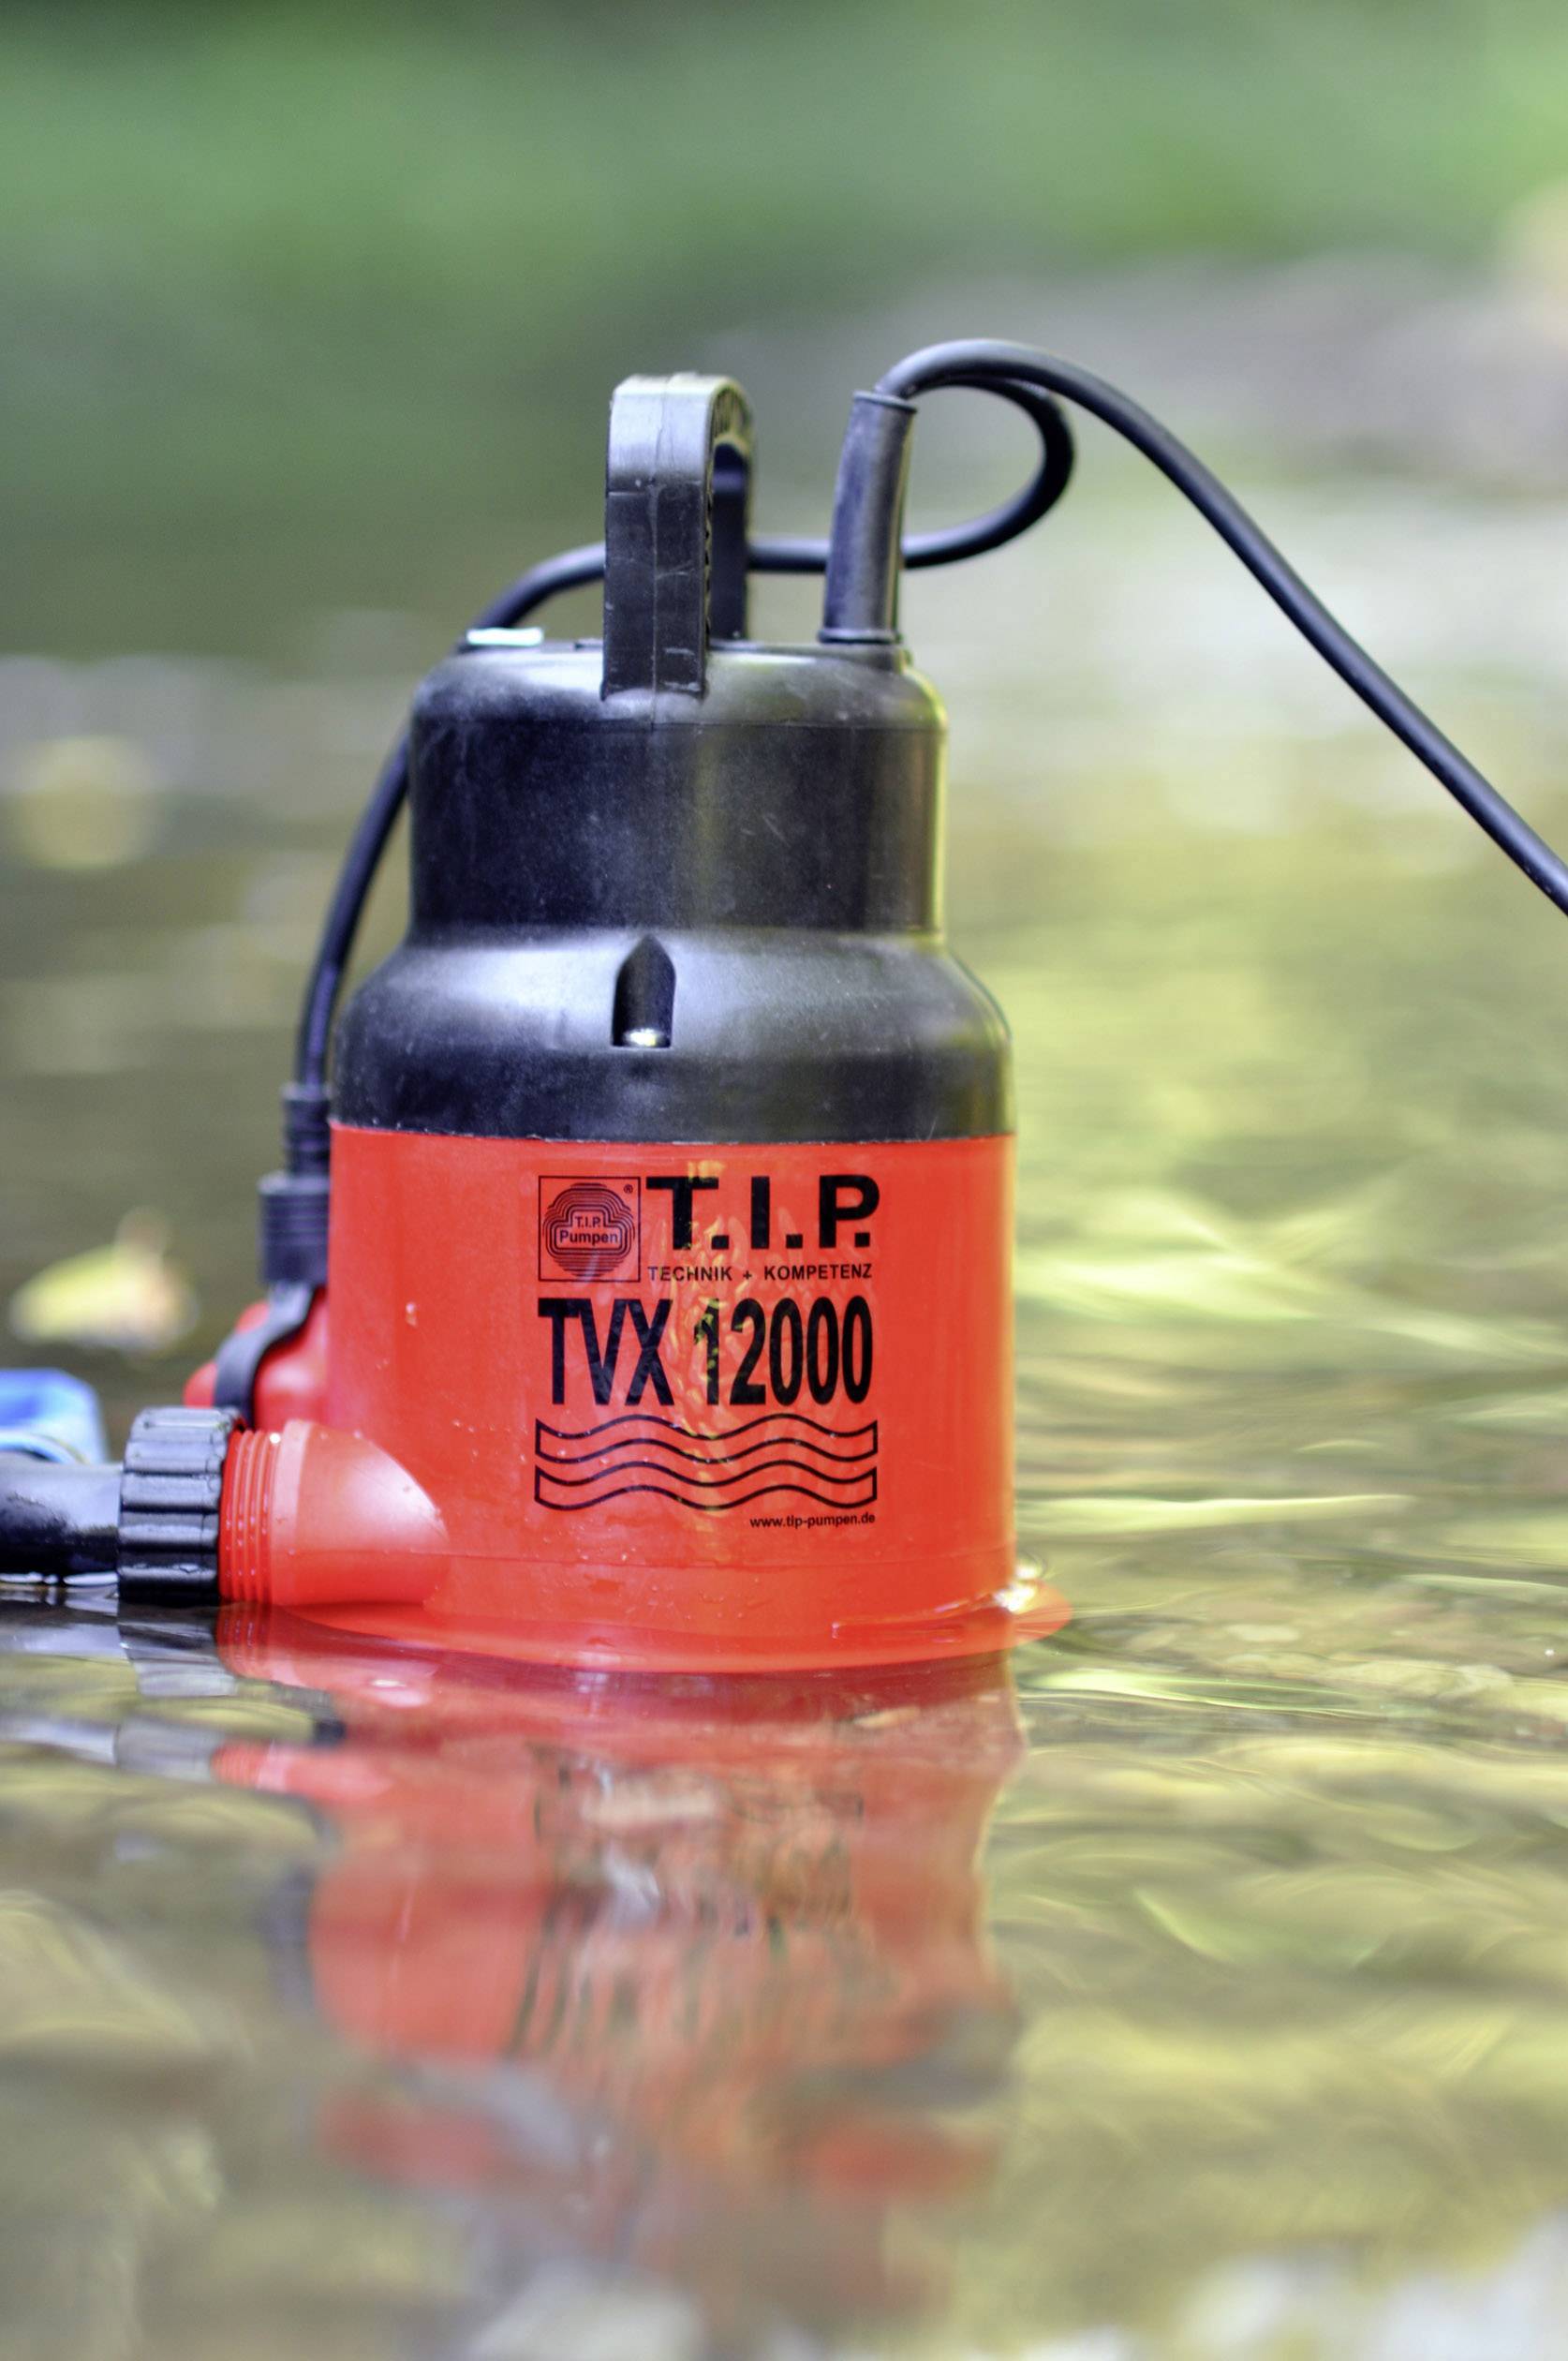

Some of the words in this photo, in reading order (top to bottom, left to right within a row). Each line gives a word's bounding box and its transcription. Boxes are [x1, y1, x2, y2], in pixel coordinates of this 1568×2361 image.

[646, 1174, 880, 1250] T.I.P.
[559, 1229, 618, 1246] Pumpen
[647, 1266, 732, 1281] TECHNIK
[764, 1264, 872, 1280] KOMPETENZ
[538, 1298, 674, 1406] TVX
[693, 1295, 873, 1406] 12000
[749, 1512, 876, 1529] www.tip-pumpen.de
